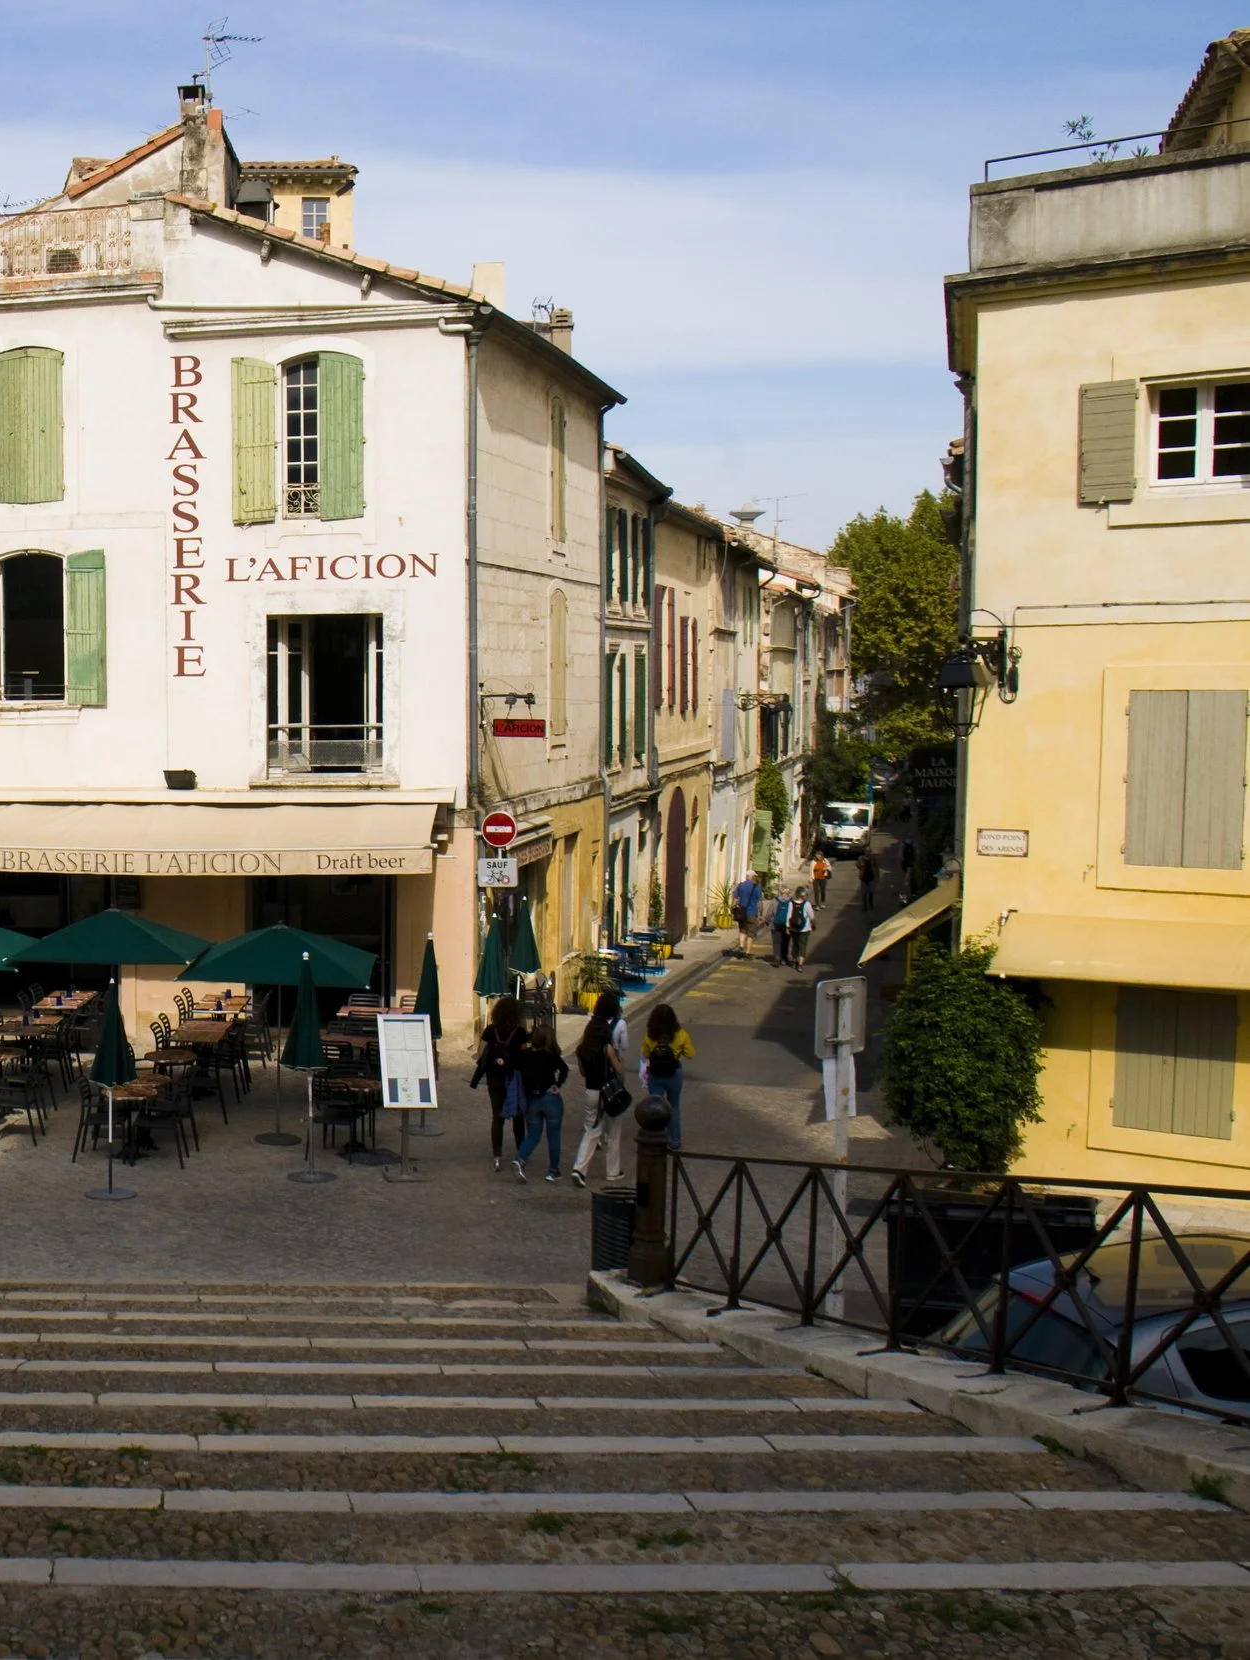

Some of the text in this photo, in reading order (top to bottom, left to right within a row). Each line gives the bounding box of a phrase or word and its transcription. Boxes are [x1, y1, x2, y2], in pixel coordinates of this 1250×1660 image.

[164, 354, 208, 678] BRASSERIE
[224, 552, 440, 583] L'AFICION
[495, 723, 545, 734] L'AFICION
[930, 757, 947, 767] LA
[0, 850, 282, 874] BRASSERIE L'AFICION
[316, 853, 406, 870] Draft beer
[486, 861, 508, 869] SAUF
